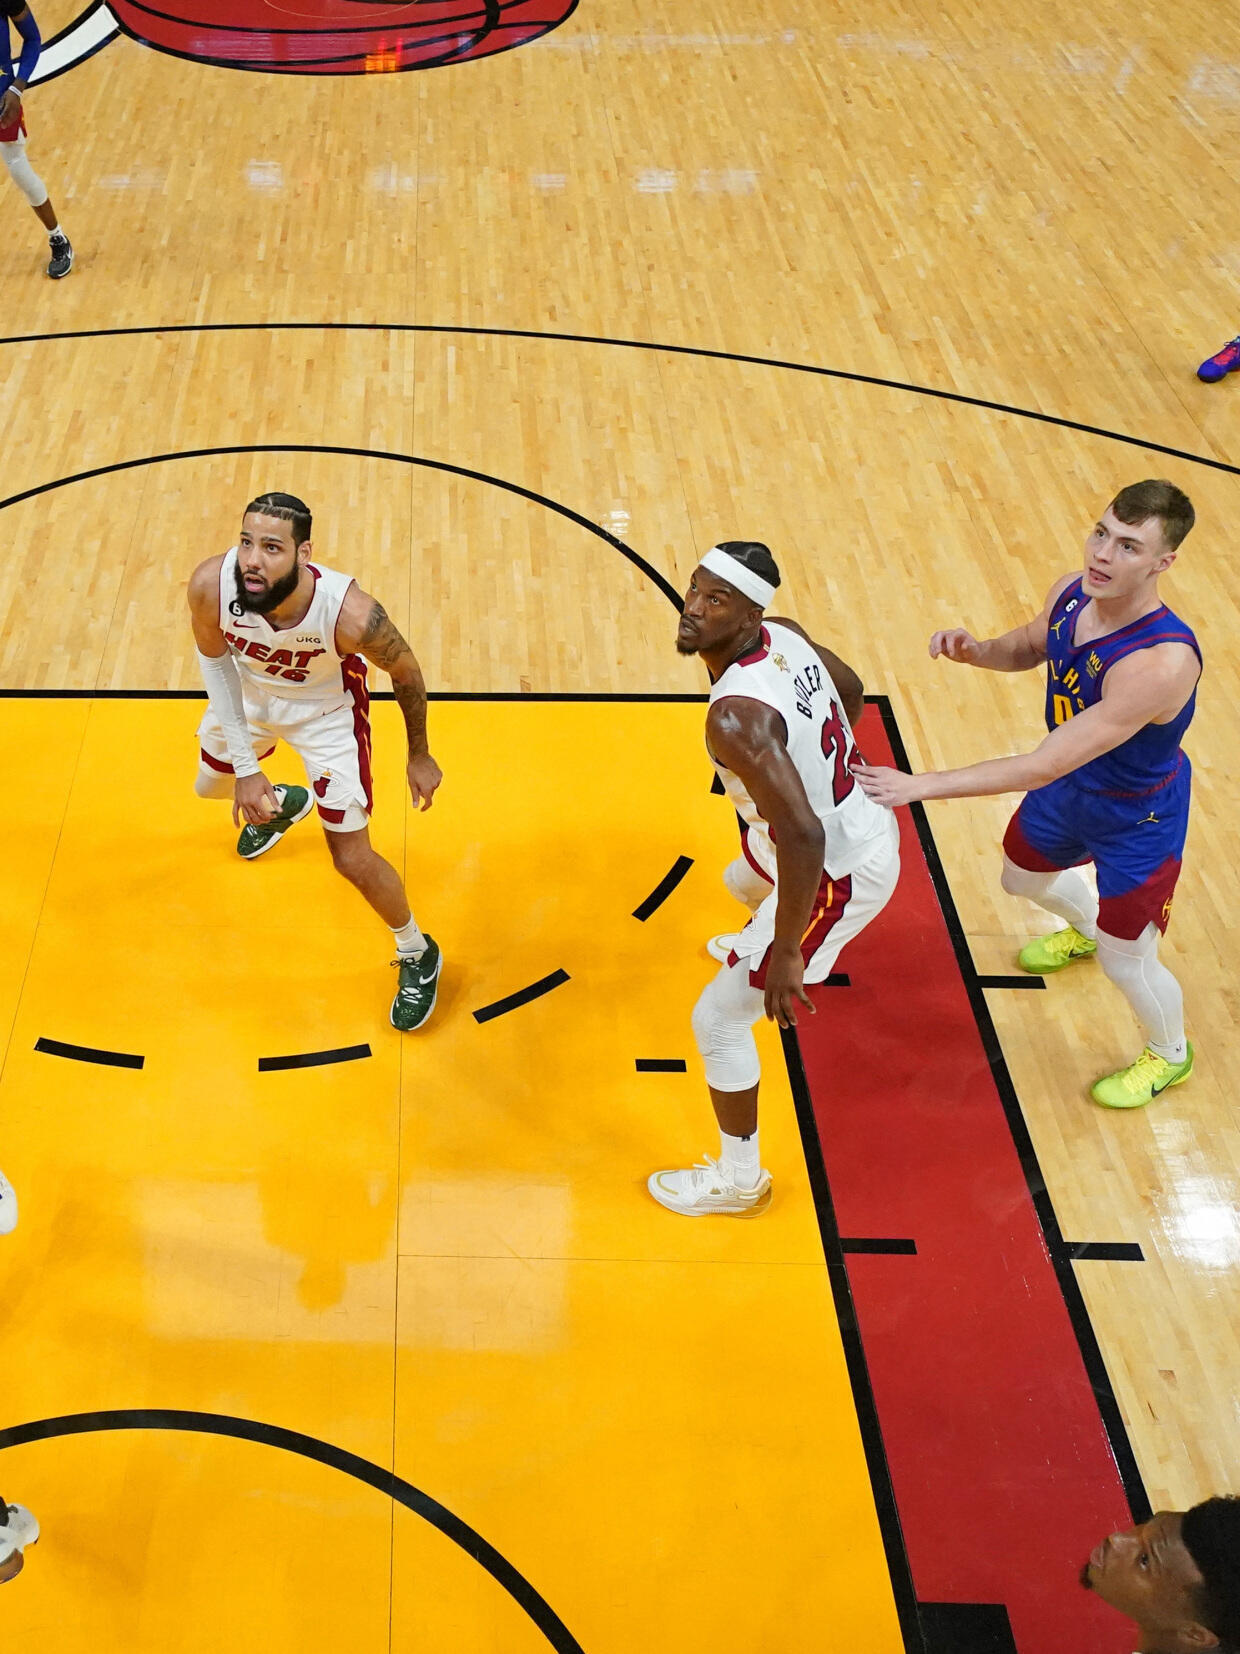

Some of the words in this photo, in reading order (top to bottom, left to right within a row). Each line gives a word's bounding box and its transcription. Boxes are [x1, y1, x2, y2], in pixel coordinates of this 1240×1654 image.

[1065, 599, 1078, 612] 6
[296, 636, 321, 645] UKG
[225, 631, 327, 669] HEAT
[264, 664, 311, 683] 16
